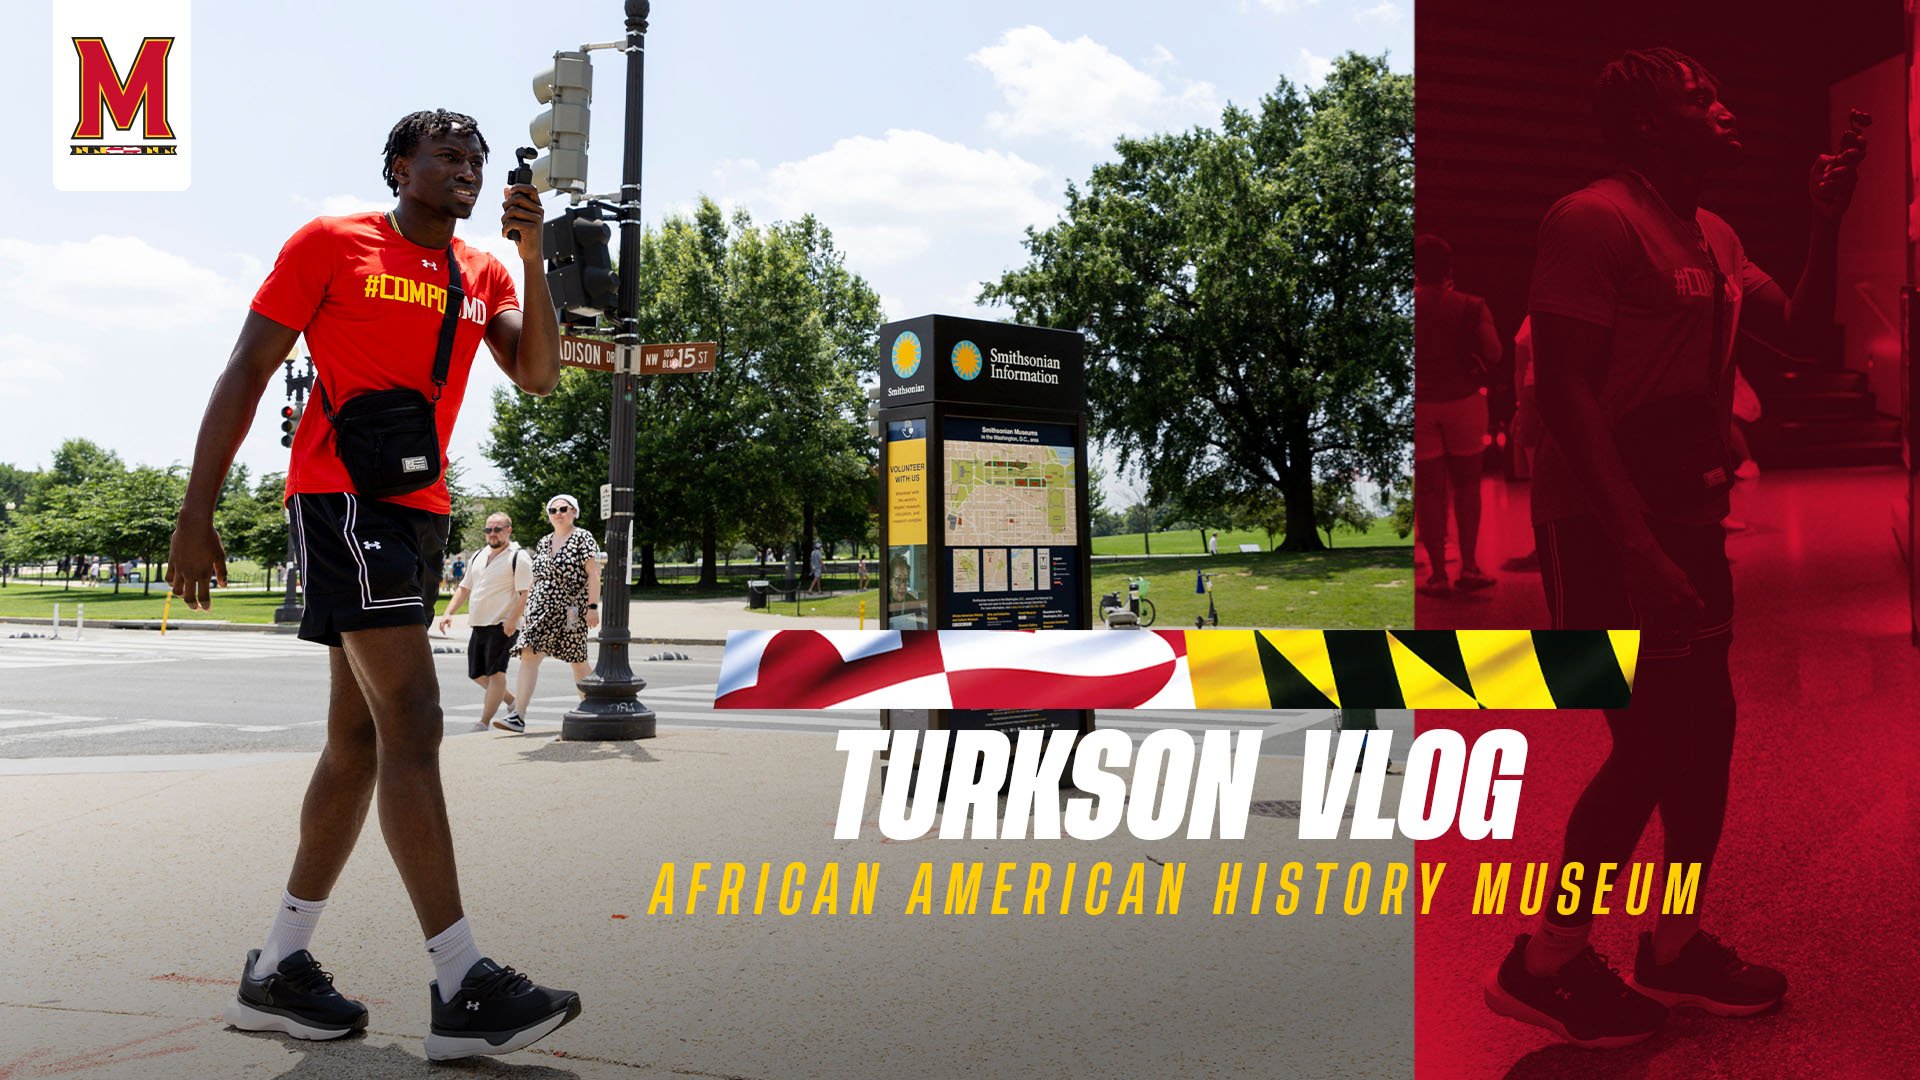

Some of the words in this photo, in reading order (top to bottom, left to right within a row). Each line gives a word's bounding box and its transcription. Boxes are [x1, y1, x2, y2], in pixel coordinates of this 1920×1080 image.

[645, 353, 659, 366] NW
[663, 348, 675, 358] 100
[678, 347, 696, 368] 15
[698, 351, 708, 364] ST
[990, 347, 1061, 370] Smithsonian
[990, 363, 1059, 385] Information
[887, 383, 925, 397] Smithsonian
[982, 426, 1014, 435] Smithsonian
[1014, 428, 1038, 437] Museums
[889, 463, 925, 473] VOLUNTEER
[895, 475, 910, 483] WITH
[911, 474, 920, 482] US
